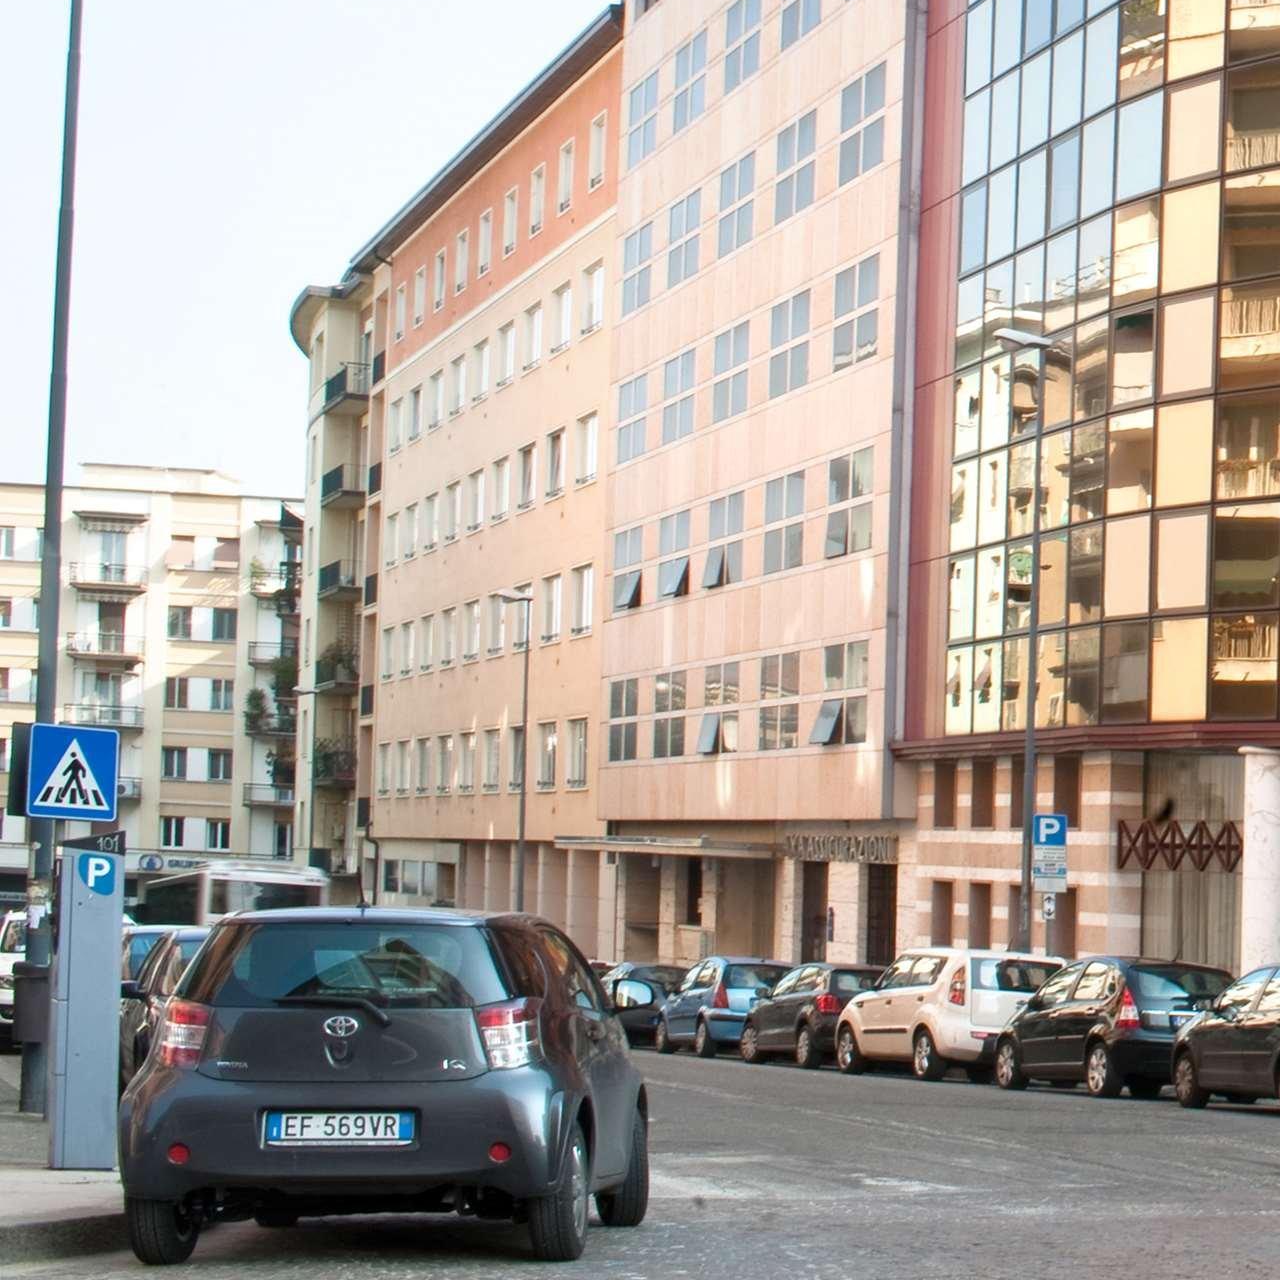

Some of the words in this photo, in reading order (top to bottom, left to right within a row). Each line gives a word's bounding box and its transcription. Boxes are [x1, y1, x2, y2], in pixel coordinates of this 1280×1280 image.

[1039, 817, 1060, 843] P
[96, 835, 120, 853] 101
[87, 857, 111, 888] P
[284, 1115, 313, 1137] EF
[323, 1115, 396, 1137] 569VR
